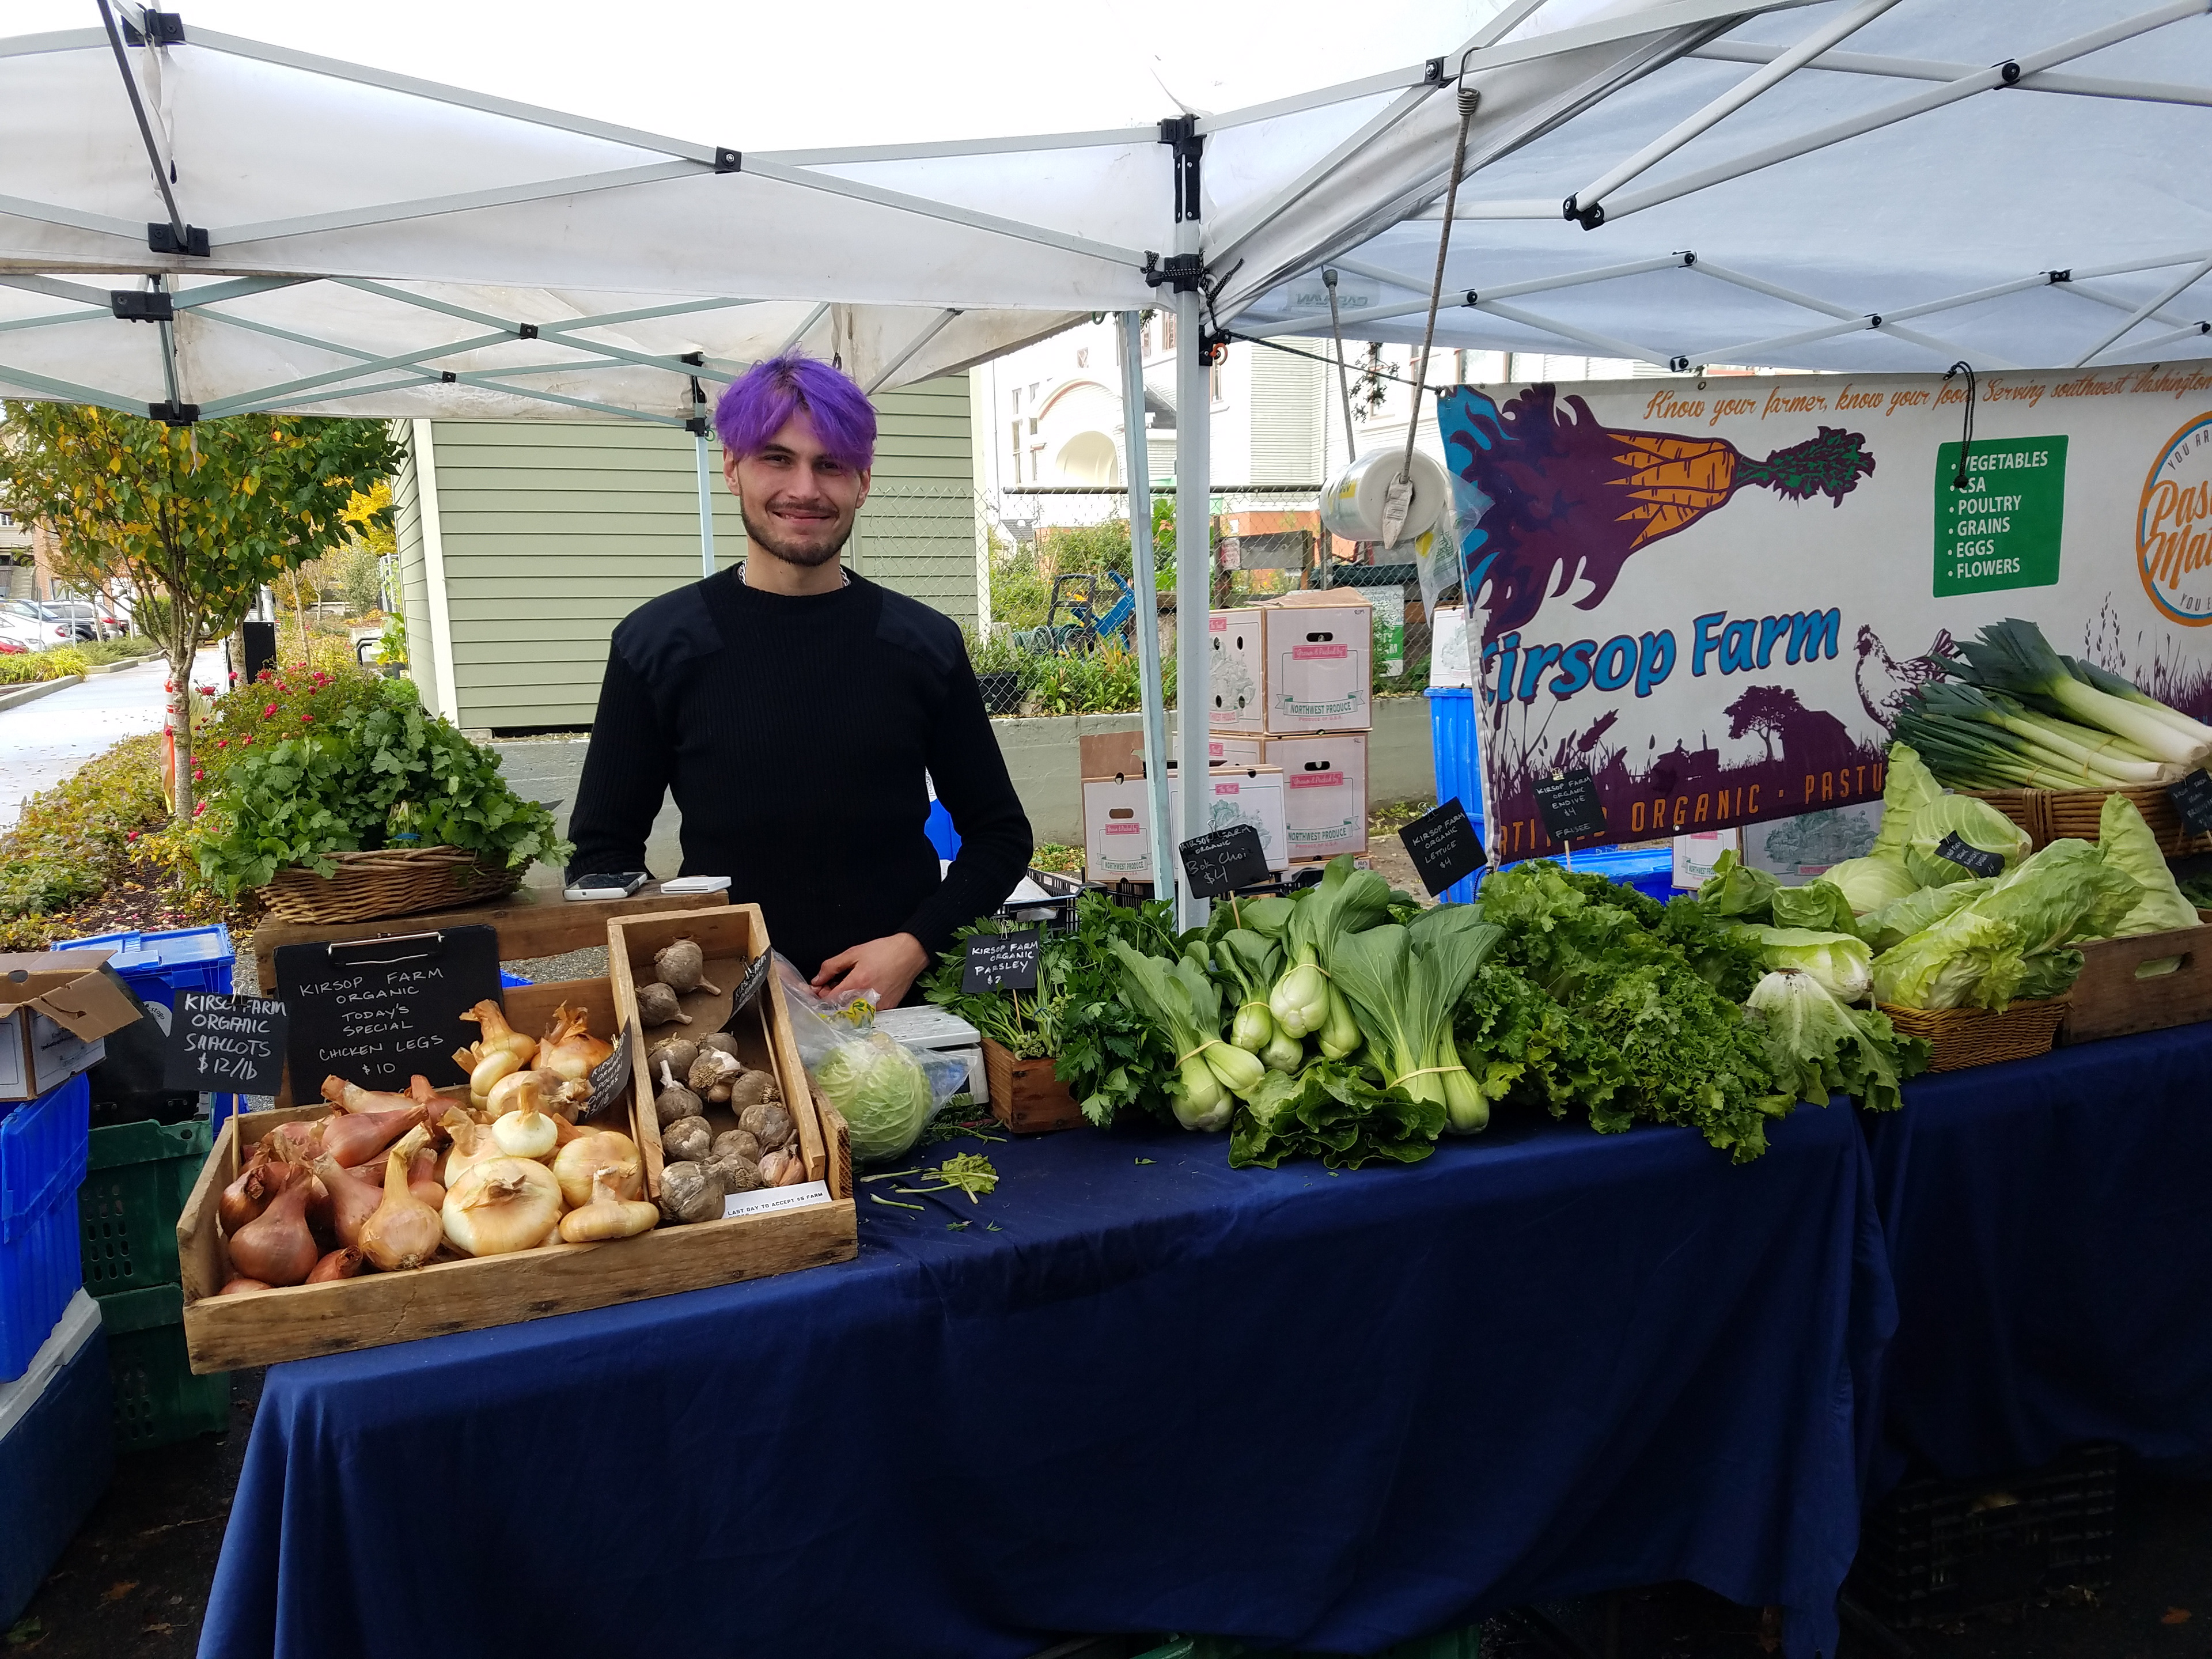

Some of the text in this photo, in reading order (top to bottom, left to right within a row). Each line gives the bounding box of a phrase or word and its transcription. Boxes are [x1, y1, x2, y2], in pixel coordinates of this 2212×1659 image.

[1643, 390, 1705, 419] Know
[1709, 397, 1756, 427] your
[1761, 385, 1828, 420] farmer,
[1835, 383, 1884, 411] know
[1886, 390, 1930, 416] your
[1982, 378, 2046, 408] Serving
[2051, 373, 2133, 397] southwest
[2168, 442, 2190, 471] YOU
[1959, 495, 2022, 515] POULTRY
[2150, 480, 2212, 536] Pas
[1957, 517, 2010, 536] GRAINS
[1956, 540, 1994, 558] EGGS
[1957, 558, 2020, 578] FLOWERS
[2180, 593, 2201, 611] YOU
[1692, 607, 1841, 677] Farm
[1290, 701, 1351, 714] NORTHWEST PRODUCE
[1536, 776, 1592, 794] KIRSOP FARM
[1552, 786, 1585, 800] ORGANIC
[1551, 795, 1585, 809] ENDIVE
[1631, 784, 1760, 832] ORGANIC
[1805, 763, 1883, 804] PASTU
[1564, 807, 1577, 817] $4
[1288, 828, 1347, 841] NORTHWEST PRODUCE
[1412, 812, 1466, 847] KIRSOP FARM
[1425, 826, 1458, 849] ORGANIC
[1555, 823, 1591, 838] FRISEE
[1195, 840, 1231, 854] ORGANIC
[1425, 840, 1457, 864] LETTUCE
[1105, 861, 1144, 870] NORTHWEST PRODUCE
[1185, 847, 1247, 874] Bok Choi
[1440, 857, 1452, 869] $4
[1203, 865, 1229, 885] $4
[972, 940, 1038, 955] KIRSOP FARM
[990, 951, 1035, 961] ORGANIC
[975, 960, 1028, 976] PARSLEY
[300, 968, 444, 997] KIRSOP FARM
[336, 986, 419, 1004] ORGANIC
[184, 993, 287, 1017] KIRSO FARM
[191, 1014, 270, 1033] ORGANIC
[343, 1020, 414, 1037] SPECIAL
[184, 1033, 272, 1057] SHALLOTS
[319, 1035, 444, 1061] CHICKEN LEGS
[594, 1060, 623, 1092] IPOLLINI
[588, 1074, 619, 1105] ONIONS
[728, 1208, 744, 1216] LAST
[771, 1198, 795, 1207] ACCEPT
[806, 1192, 823, 1200] FARM
